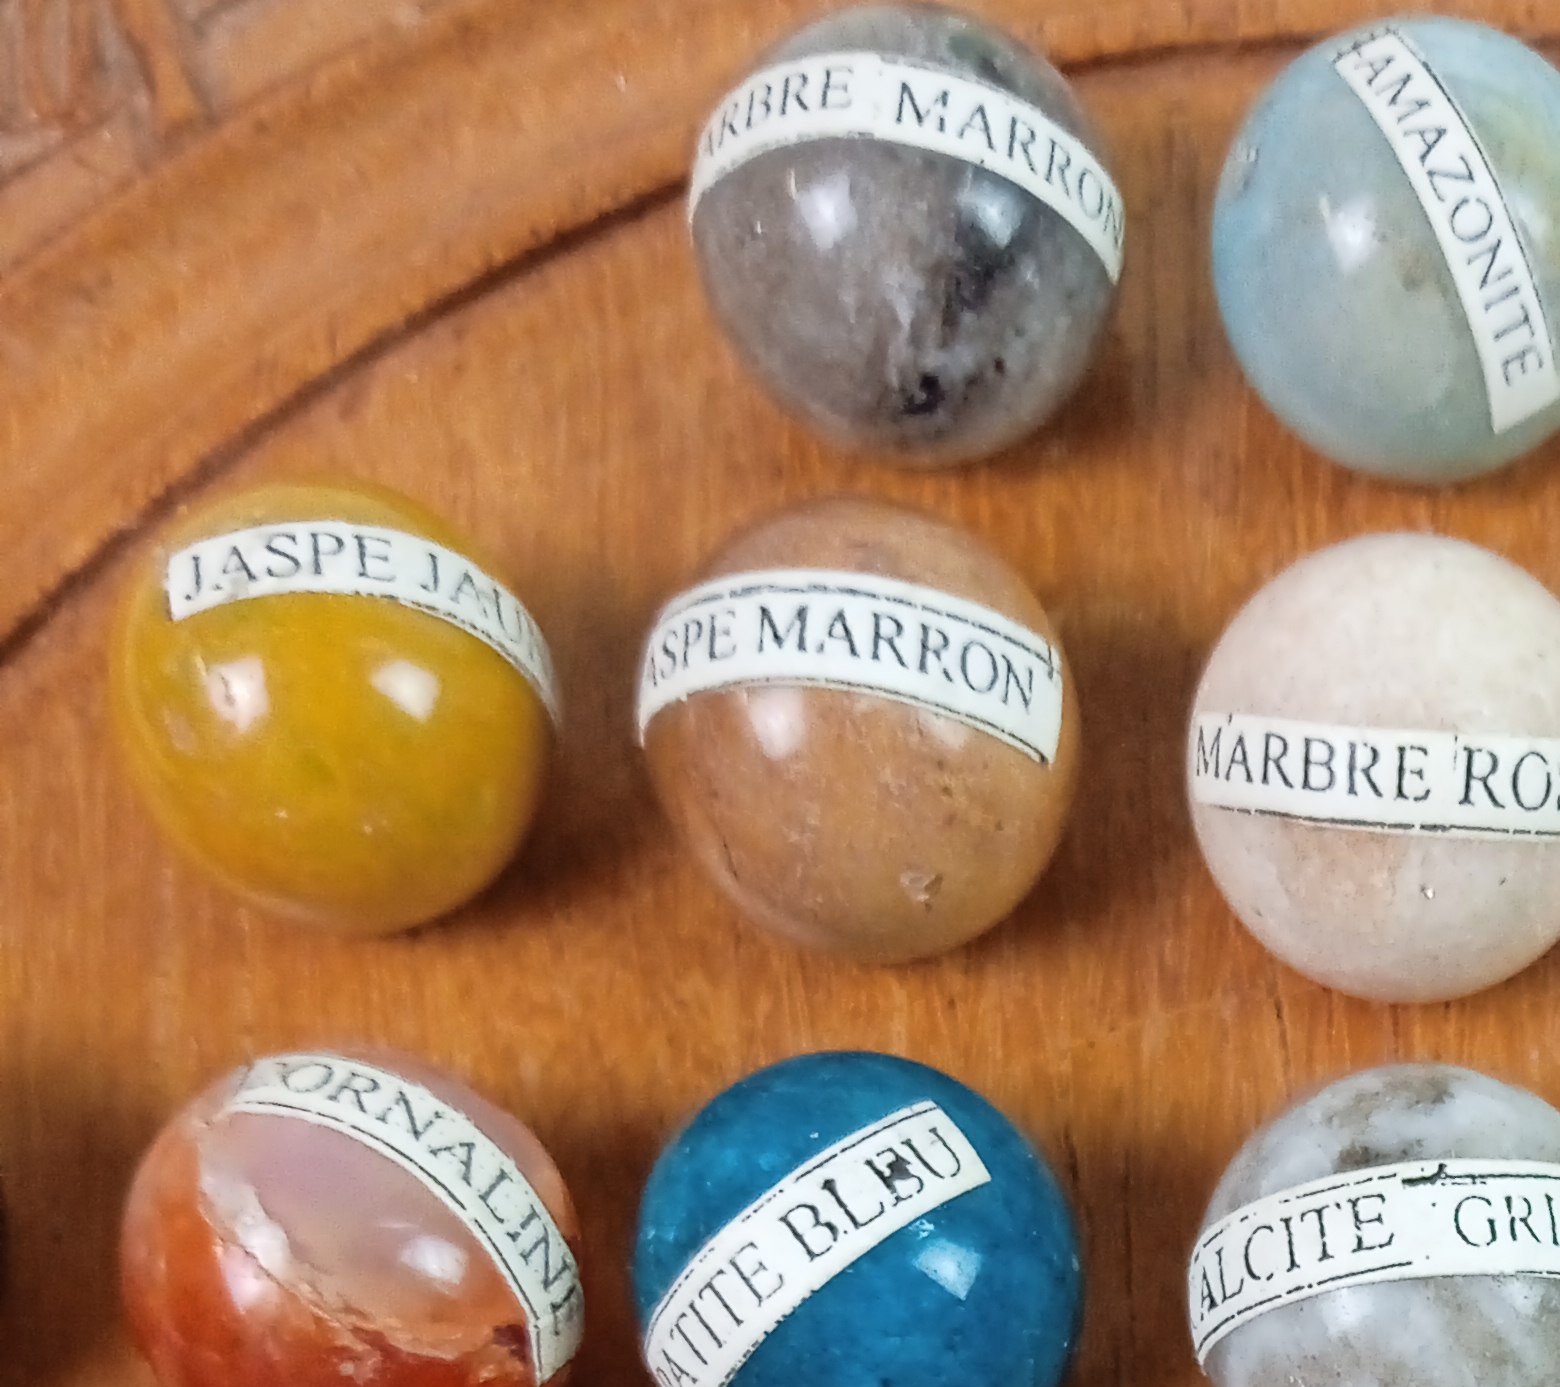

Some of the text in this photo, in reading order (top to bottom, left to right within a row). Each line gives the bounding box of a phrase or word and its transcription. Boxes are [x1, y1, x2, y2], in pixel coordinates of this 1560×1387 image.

[1352, 54, 1545, 388] AMAZONITE
[184, 532, 397, 602] JASPE
[757, 604, 1033, 714] MARRON
[1195, 726, 1432, 802] MARBRE
[778, 1127, 963, 1263] BLEU
